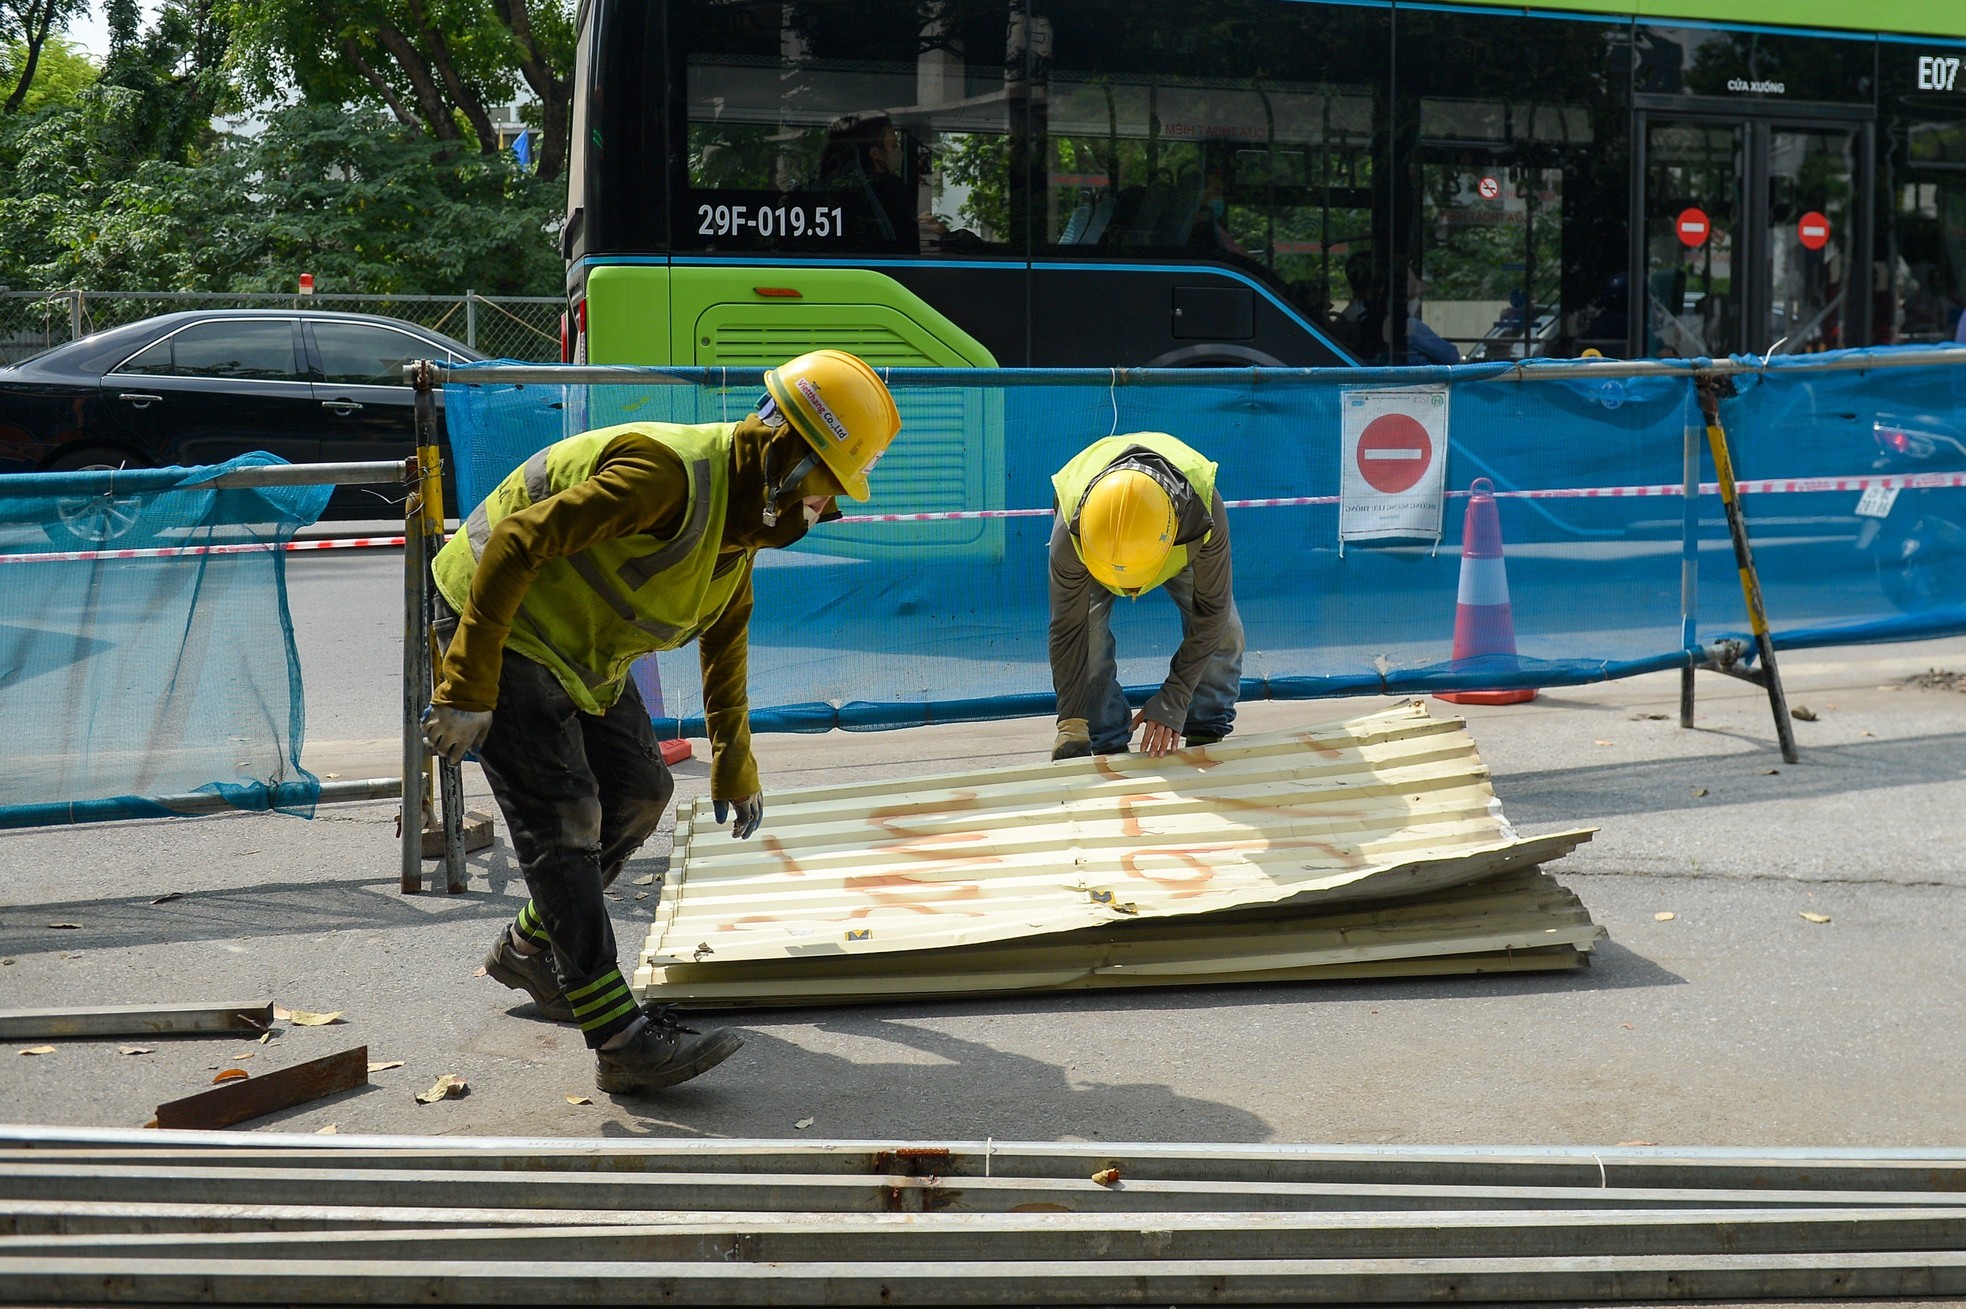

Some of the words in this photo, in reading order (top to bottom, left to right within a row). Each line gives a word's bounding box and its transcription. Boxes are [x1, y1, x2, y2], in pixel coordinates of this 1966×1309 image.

[1918, 55, 1960, 91] E07
[698, 204, 842, 237] 29F-019.51
[798, 380, 826, 415] Vietthang
[823, 412, 848, 439] Co.,Ltd
